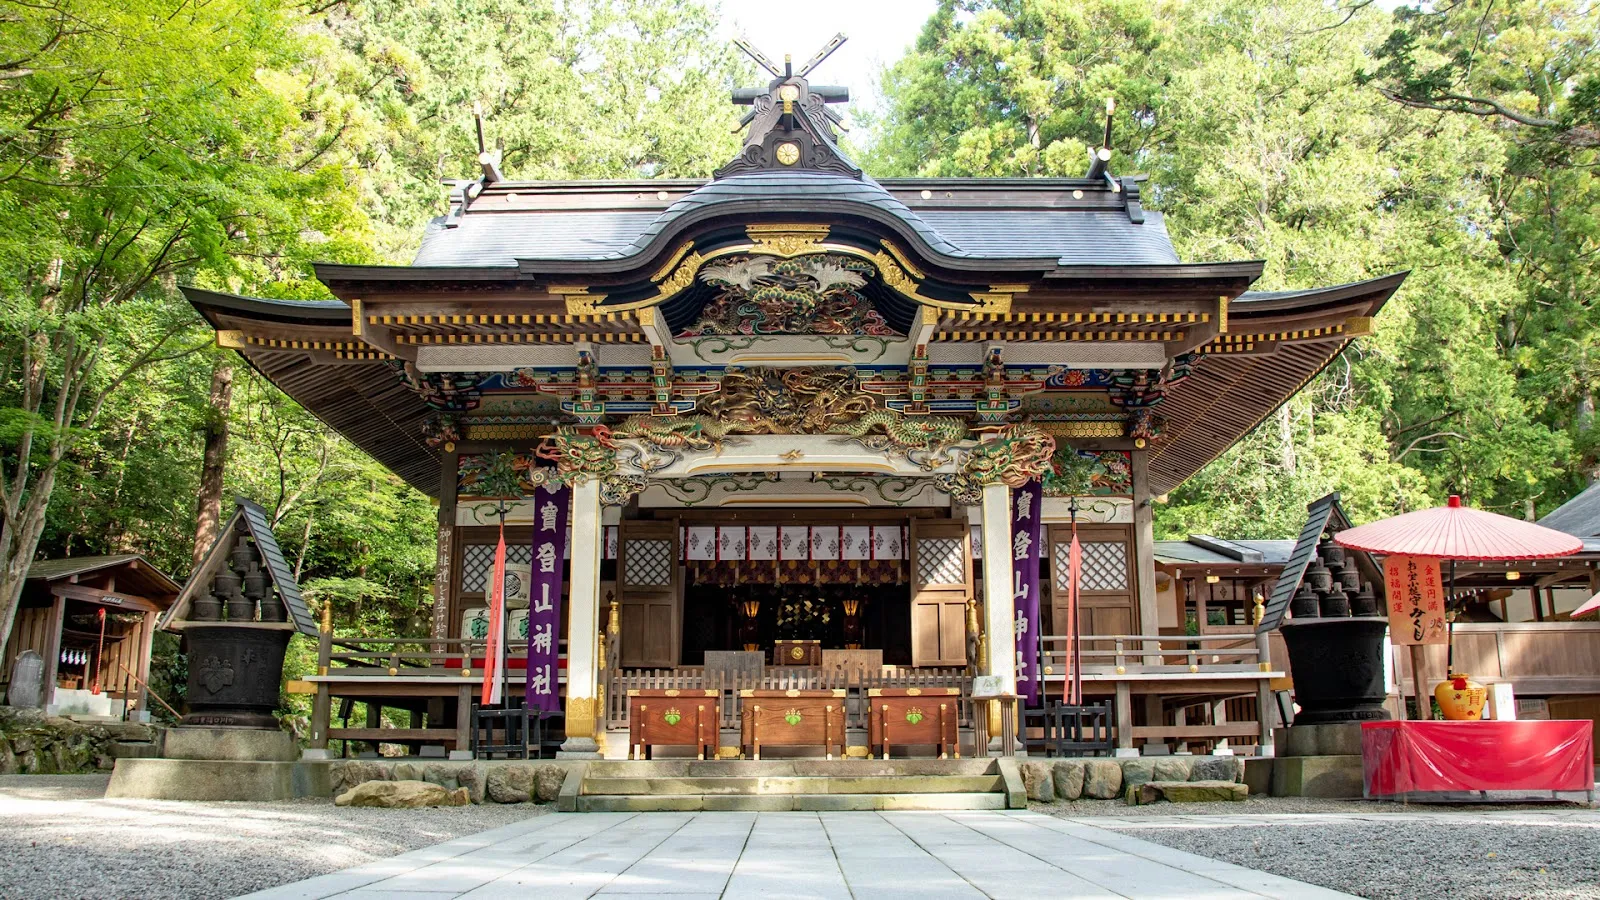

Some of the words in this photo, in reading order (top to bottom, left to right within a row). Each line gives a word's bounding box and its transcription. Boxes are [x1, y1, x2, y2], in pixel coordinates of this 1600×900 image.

[530, 500, 560, 696] 寶登山神社
[1389, 566, 1404, 614] 招福開運
[1425, 564, 1439, 612] 金運円満
